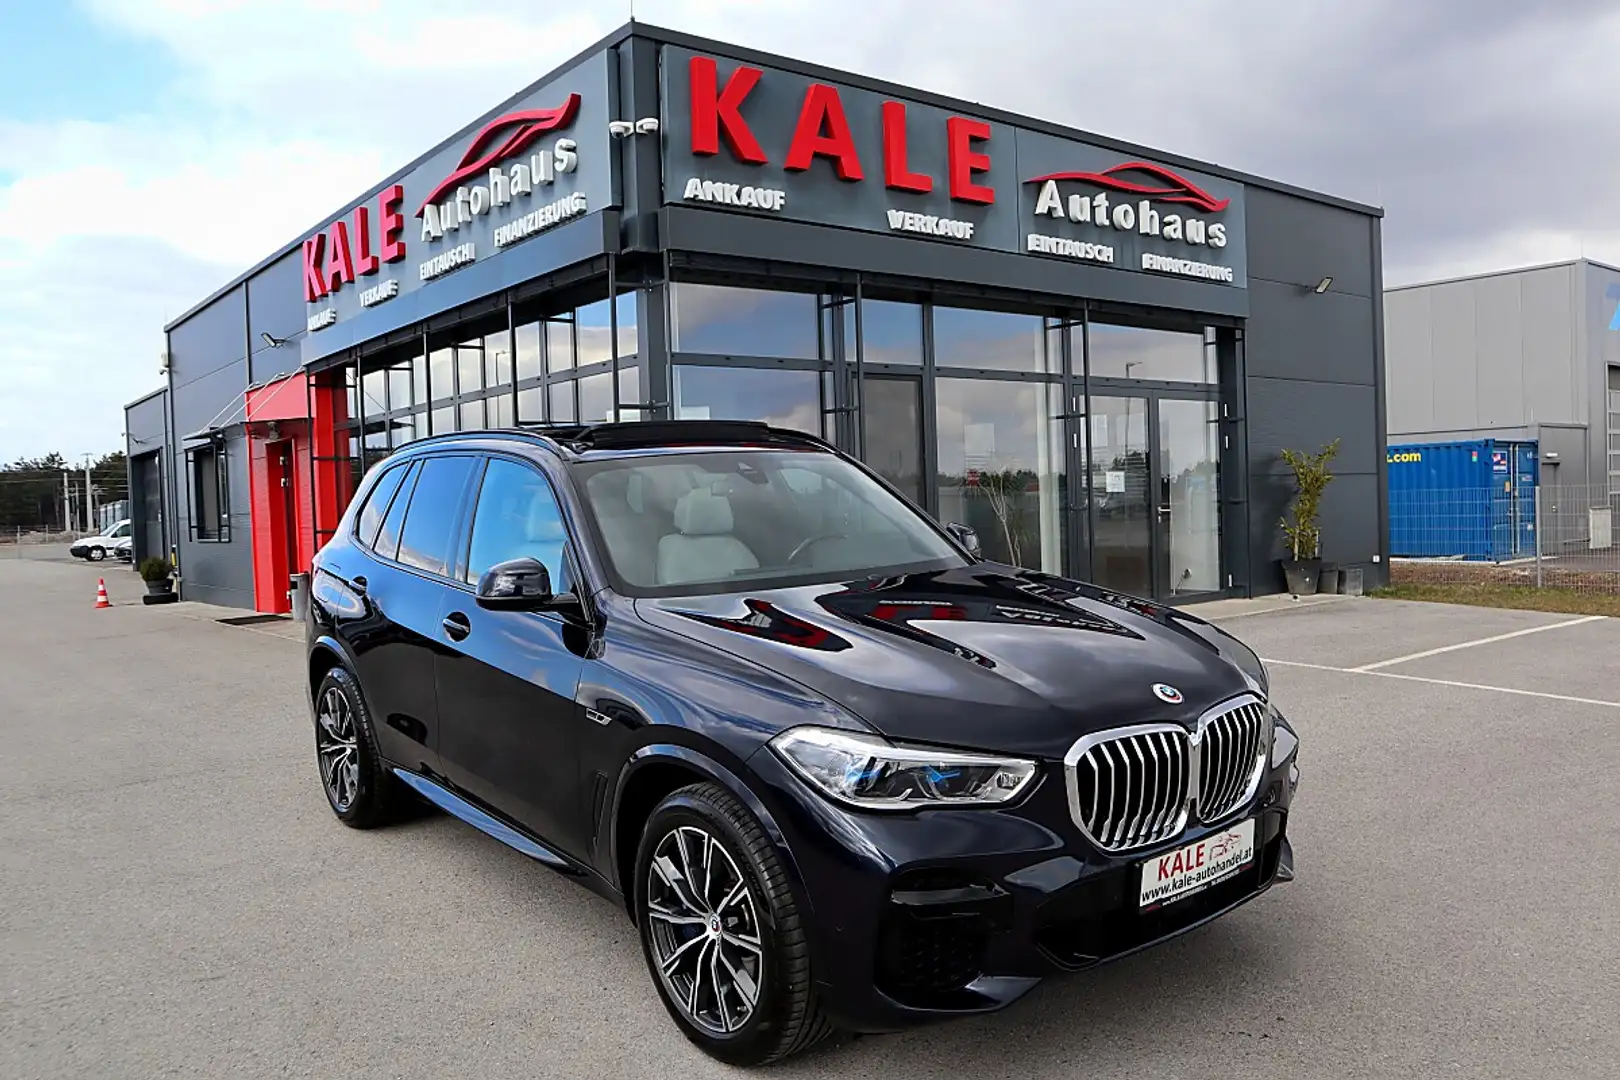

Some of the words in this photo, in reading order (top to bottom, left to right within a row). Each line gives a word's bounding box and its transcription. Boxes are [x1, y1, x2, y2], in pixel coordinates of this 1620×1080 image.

[690, 56, 995, 205] KALE
[421, 138, 578, 242] Autohaus
[683, 177, 786, 211] ANKAUF
[1033, 179, 1228, 249] Autohaus
[302, 184, 406, 303] KALE
[494, 191, 588, 248] FINANZIERUNG
[887, 209, 975, 240] VERKAUF
[419, 242, 476, 281] EINTAUSCH
[1027, 233, 1114, 264] EINTAUSCH
[1141, 253, 1233, 282] FINANZIERUNG
[1142, 846, 1253, 903] www.kale-autohandel.at
[1158, 843, 1206, 881] KALE
